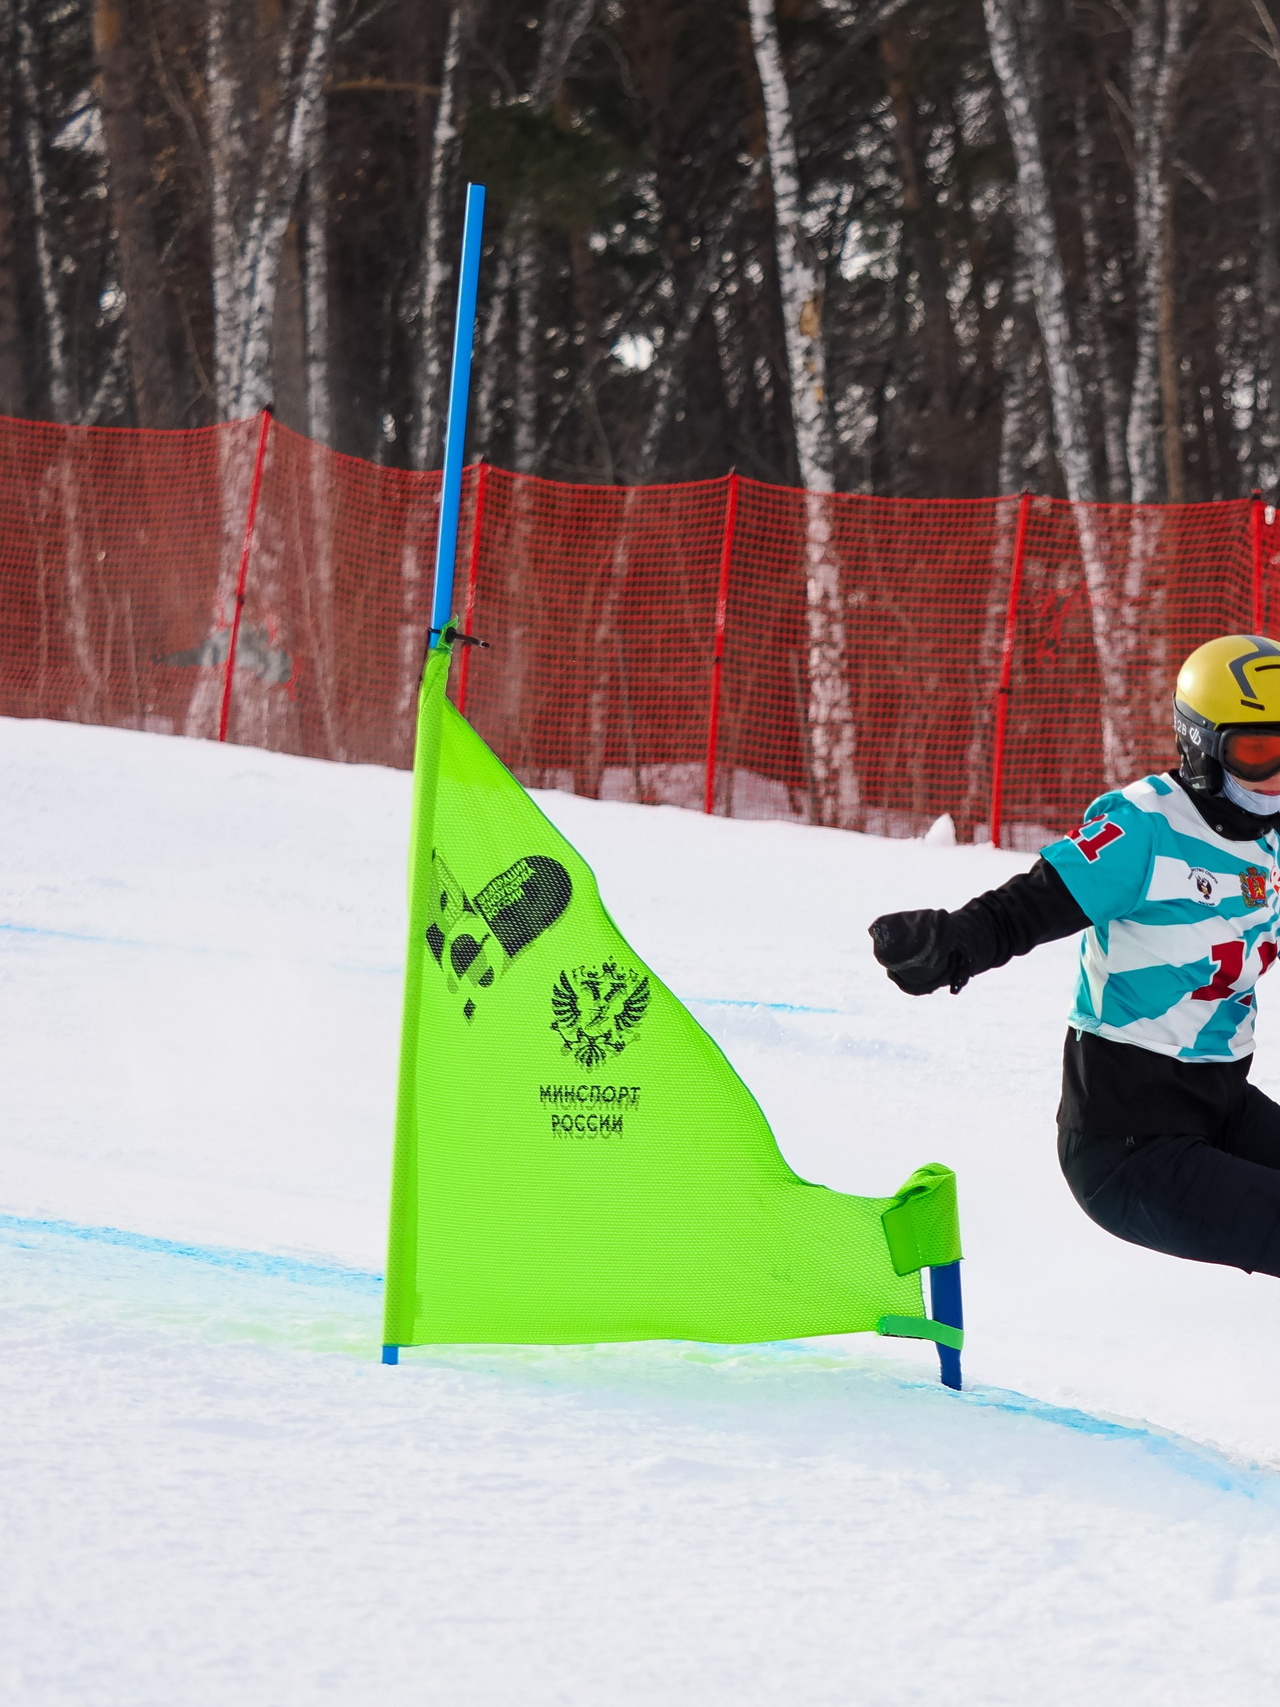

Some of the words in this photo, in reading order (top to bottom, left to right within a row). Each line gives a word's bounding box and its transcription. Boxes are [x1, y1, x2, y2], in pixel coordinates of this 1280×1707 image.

[482, 866, 537, 912] СНОУБОРДА
[486, 886, 525, 921] РОССИИ
[540, 1085, 641, 1103] МИНСПОРТ
[551, 1114, 623, 1132] РОССИИ
